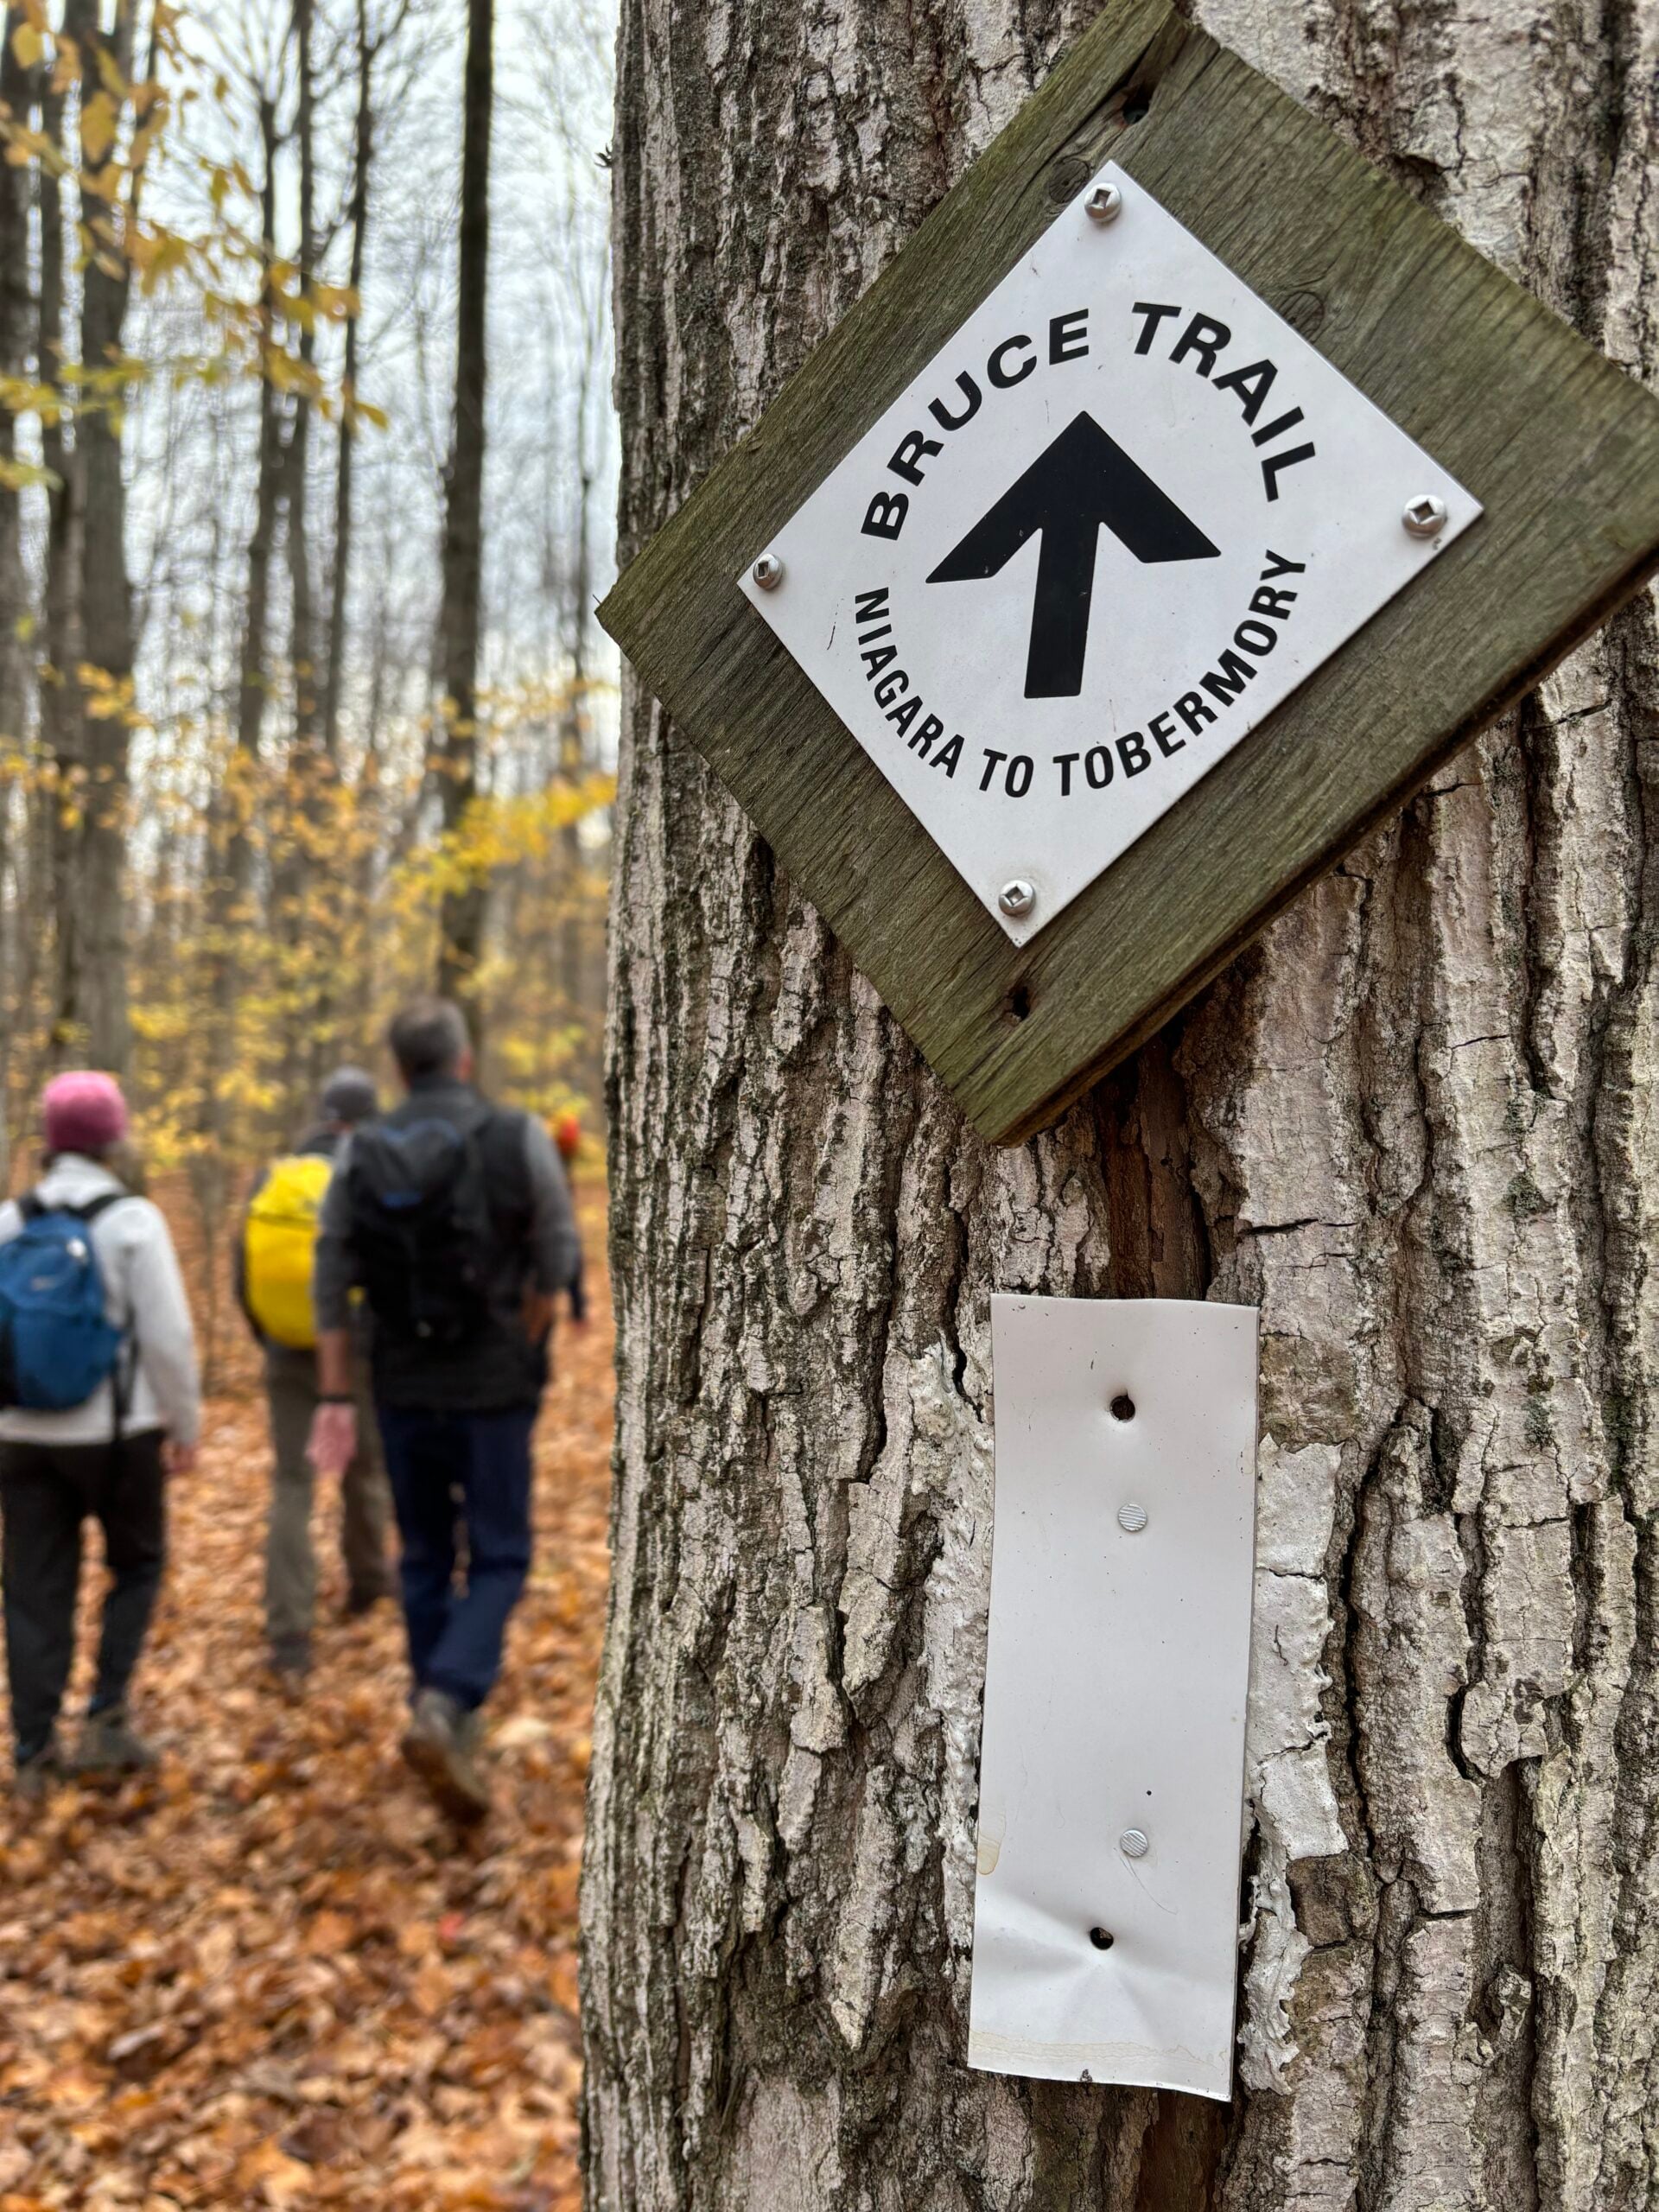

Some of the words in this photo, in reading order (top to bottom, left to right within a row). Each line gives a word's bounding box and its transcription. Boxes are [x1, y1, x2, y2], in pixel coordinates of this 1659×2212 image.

[861, 308, 1089, 540] BRUCE
[1132, 302, 1316, 502] TRAIL
[855, 587, 965, 779] NIAGARA
[978, 748, 1034, 798] TO
[1052, 550, 1306, 797] TOBERMORY
